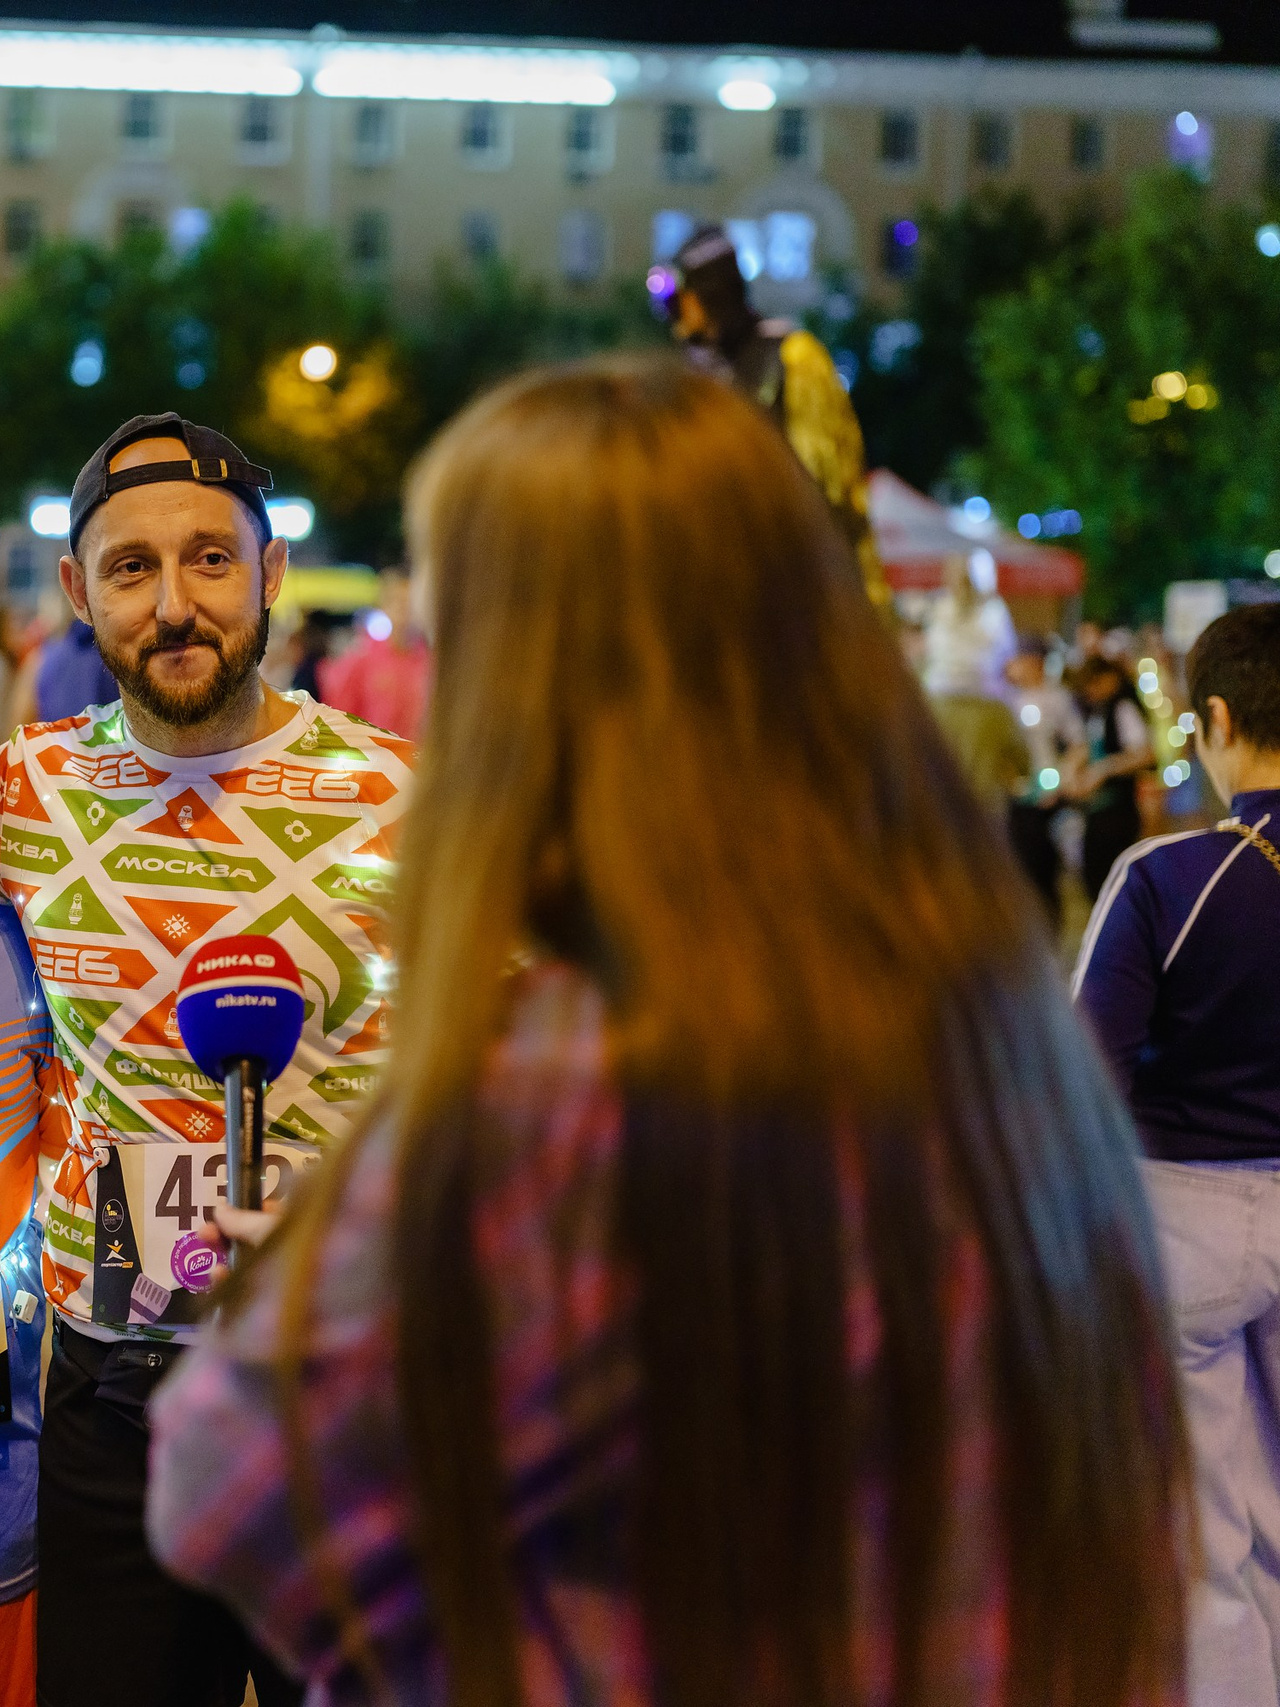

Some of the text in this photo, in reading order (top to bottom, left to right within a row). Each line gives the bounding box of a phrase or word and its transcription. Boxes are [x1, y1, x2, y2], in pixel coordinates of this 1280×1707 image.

[115, 856, 257, 882] МОСКВА
[331, 876, 392, 893] МО
[197, 954, 253, 974] НИКА
[215, 993, 277, 1008] nikatv.ru
[189, 1256, 212, 1272] Konti
